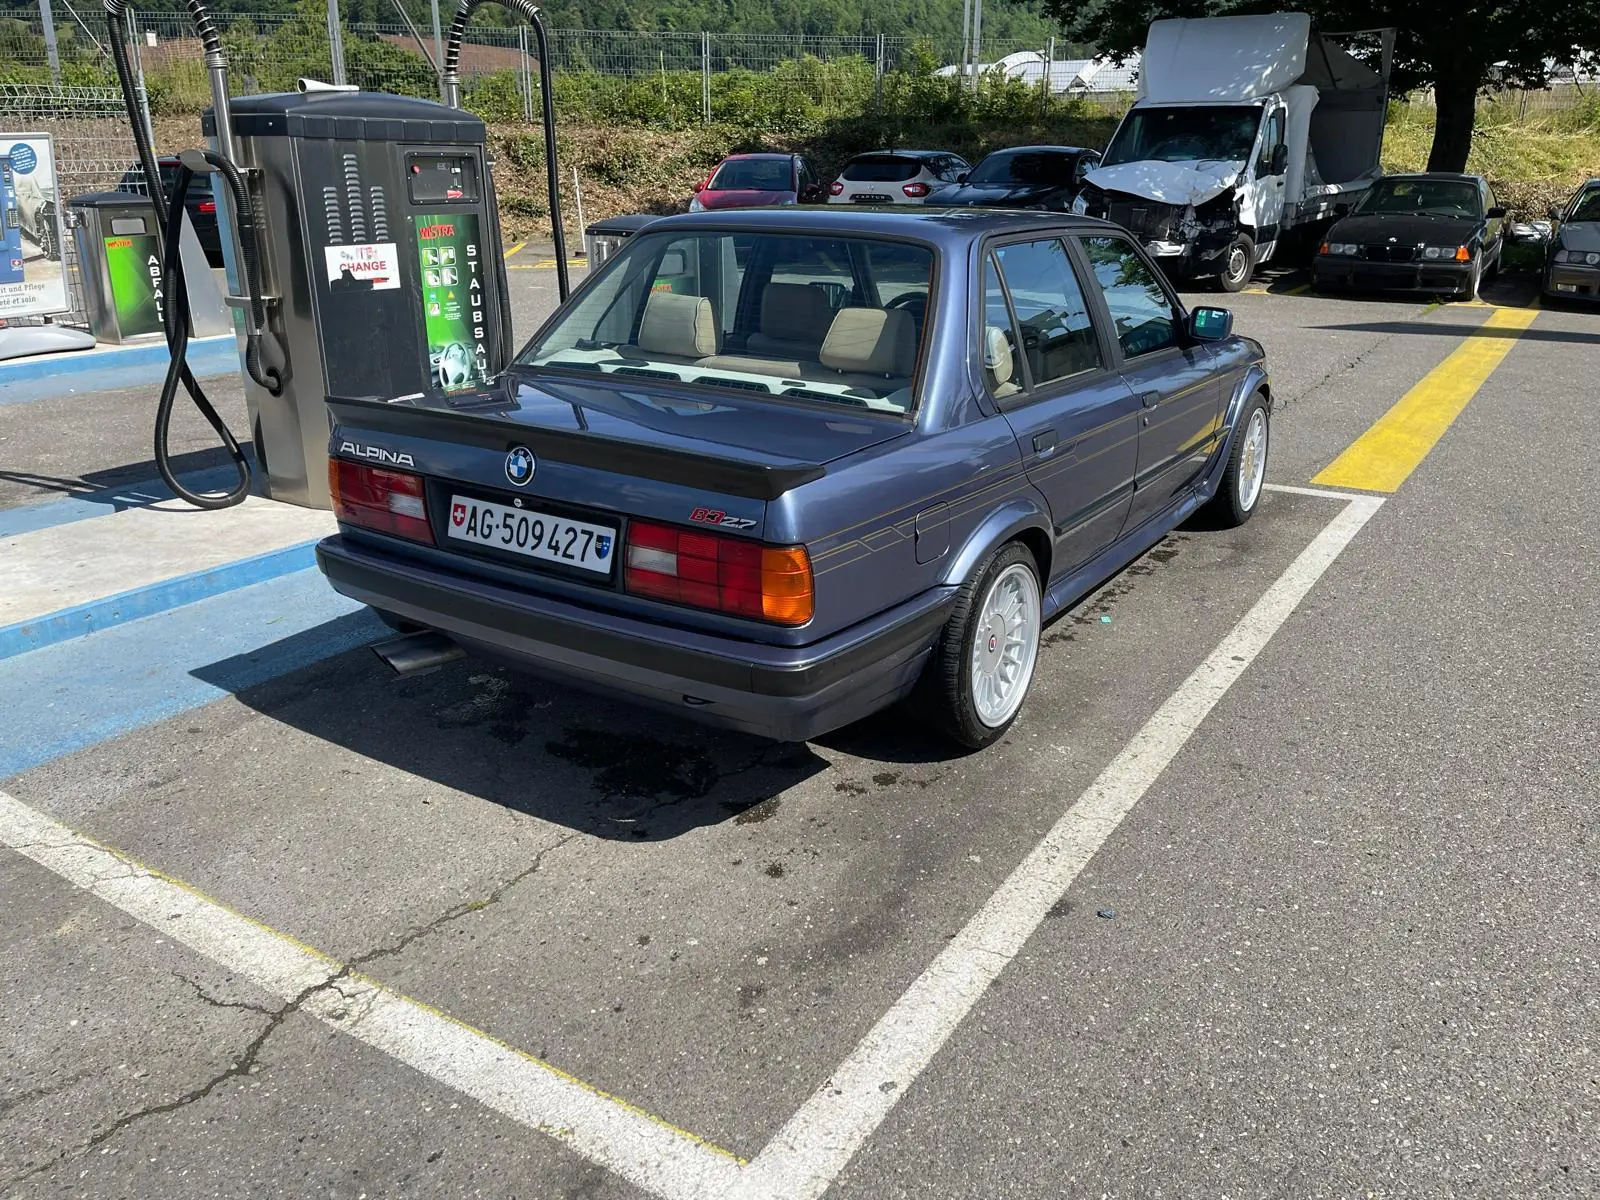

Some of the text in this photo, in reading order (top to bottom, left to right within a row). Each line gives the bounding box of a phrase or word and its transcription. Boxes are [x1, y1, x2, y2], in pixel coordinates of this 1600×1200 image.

[420, 224, 455, 239] WISTRA
[339, 260, 388, 272] CHANGE
[24, 283, 45, 291] Pflege
[147, 254, 165, 322] ABFALL
[12, 297, 20, 305] et
[22, 296, 37, 304] soin
[340, 441, 415, 467] ALPINA
